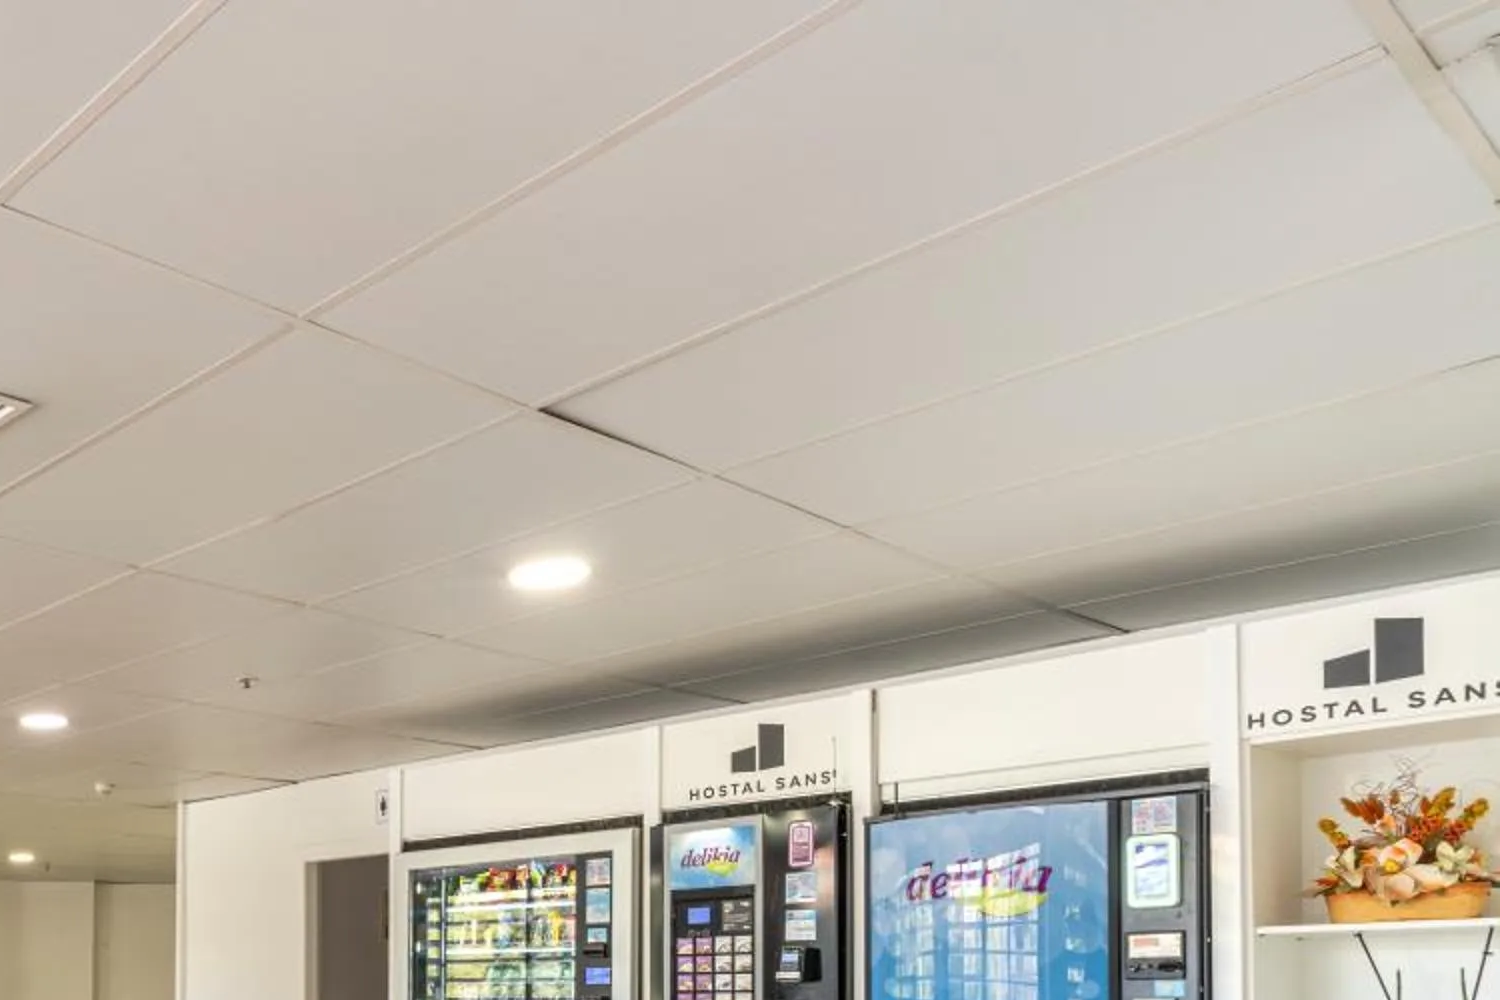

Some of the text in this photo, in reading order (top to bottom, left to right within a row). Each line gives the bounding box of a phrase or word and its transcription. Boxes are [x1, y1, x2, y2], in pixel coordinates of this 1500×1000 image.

[1247, 681, 1500, 729] HOSTAL SAN
[689, 780, 765, 801] HOSTAL
